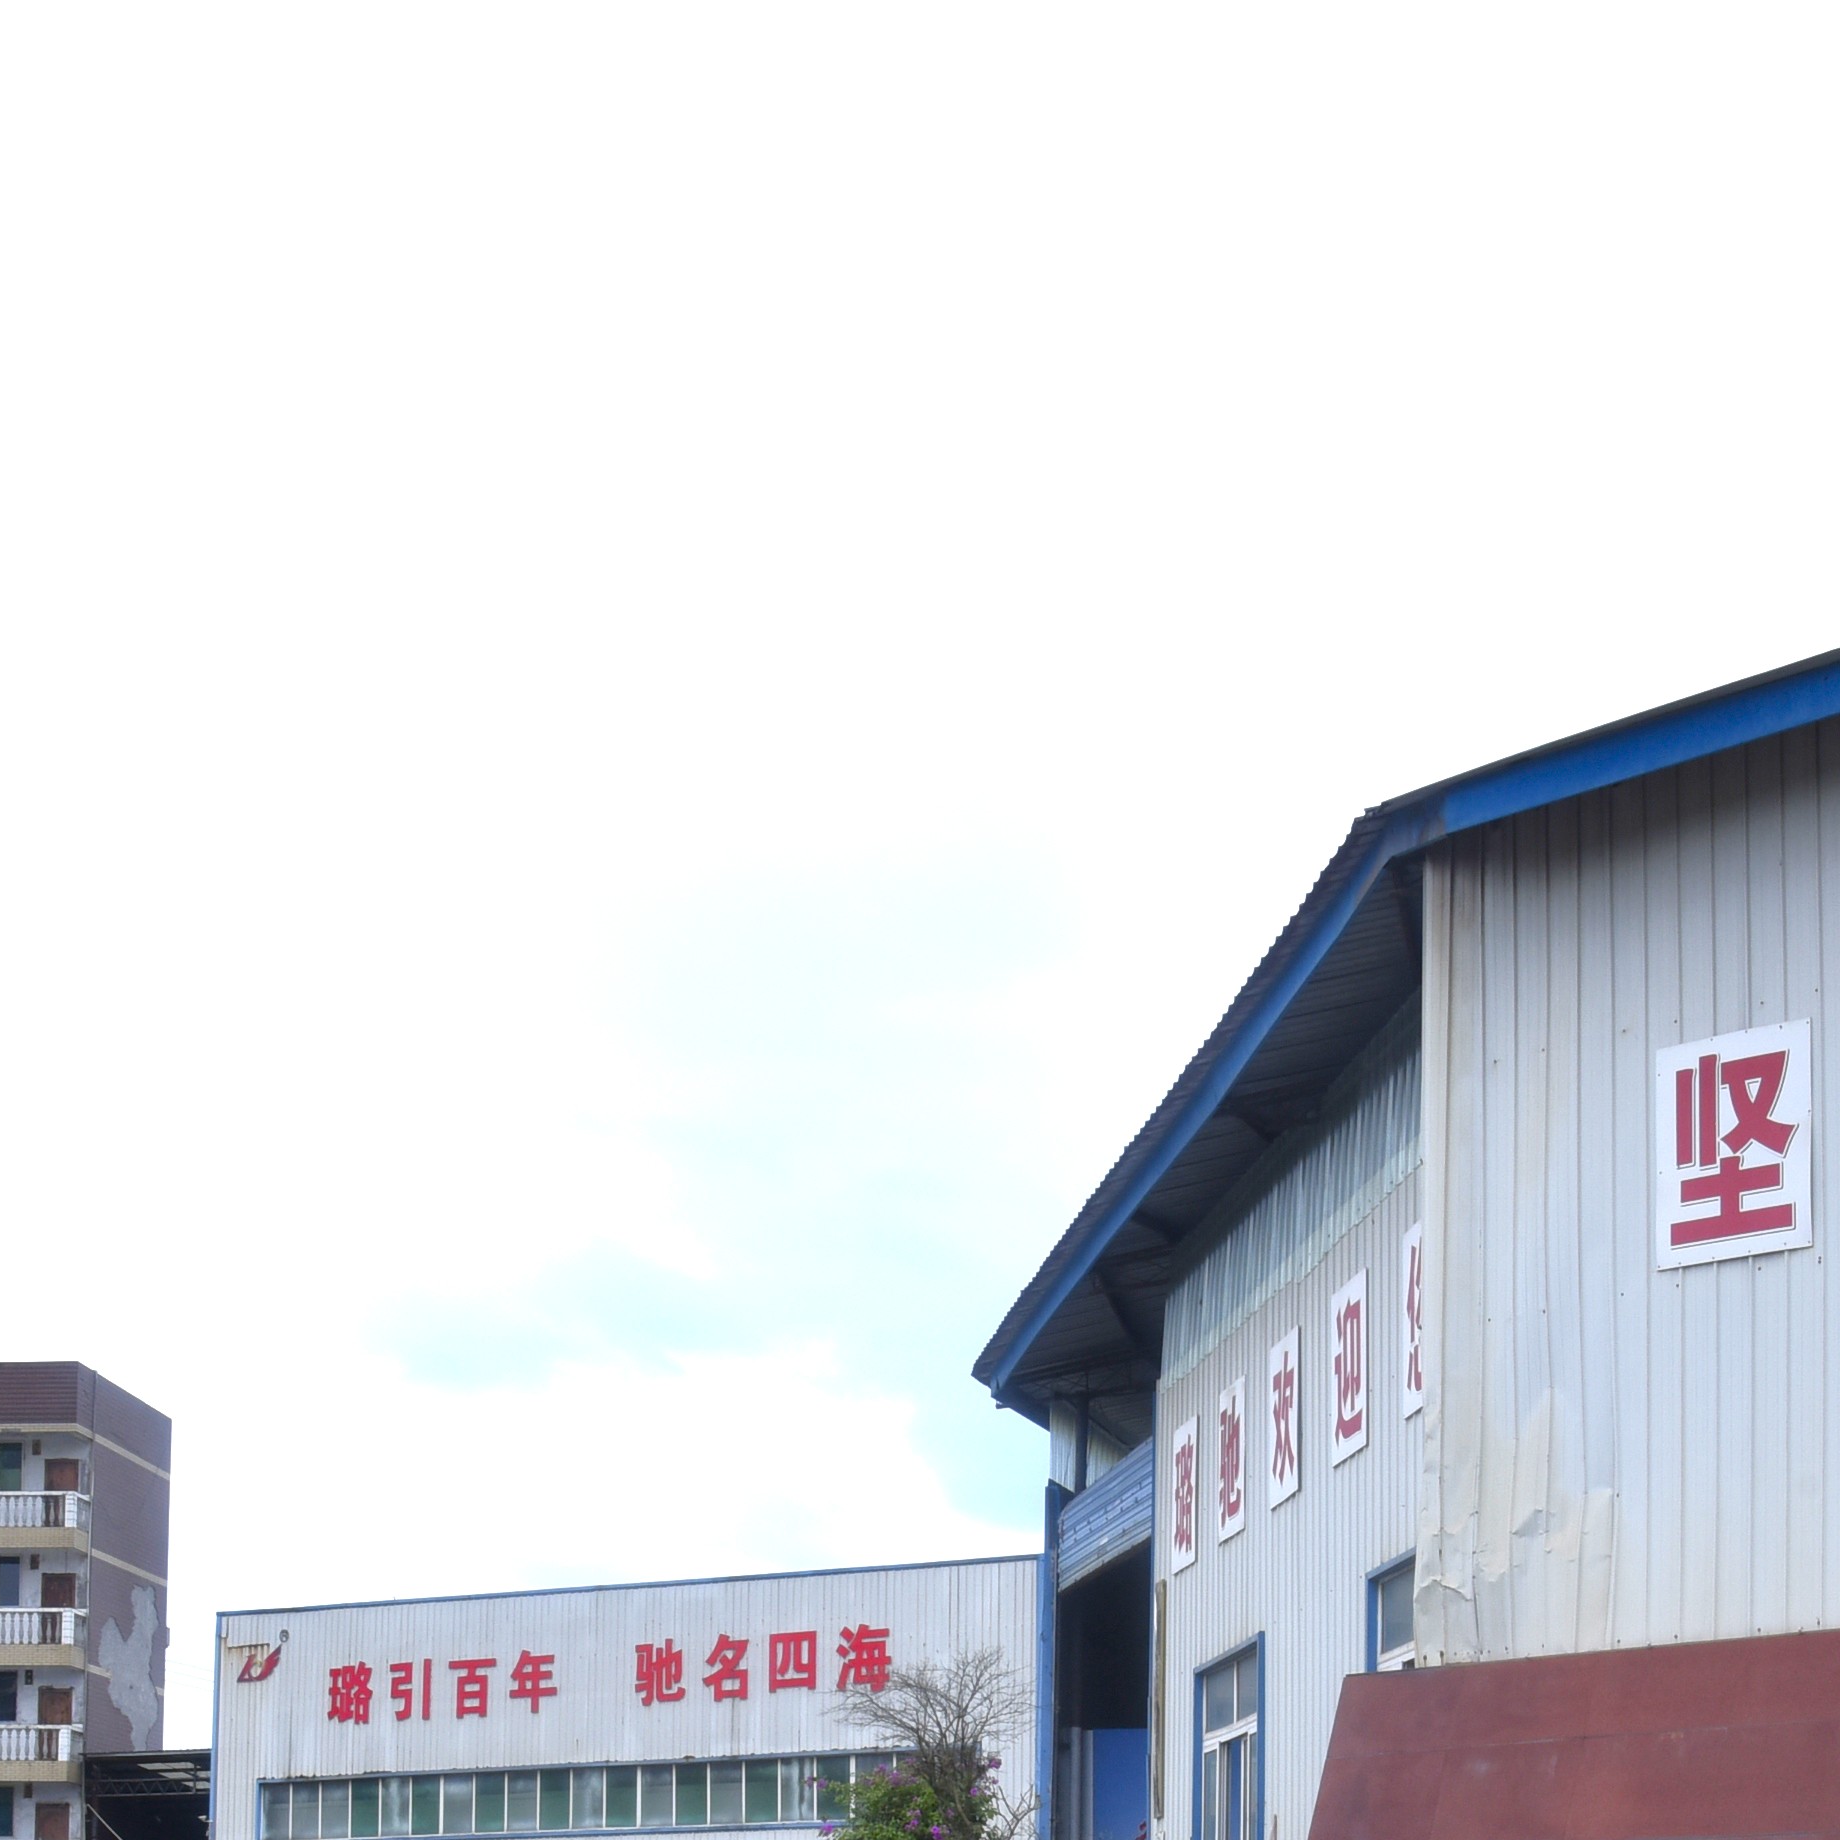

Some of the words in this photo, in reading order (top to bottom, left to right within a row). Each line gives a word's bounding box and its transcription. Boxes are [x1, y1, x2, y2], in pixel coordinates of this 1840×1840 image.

[327, 1650, 558, 1725] 璐引百年
[634, 1623, 892, 1707] 驰名四海
